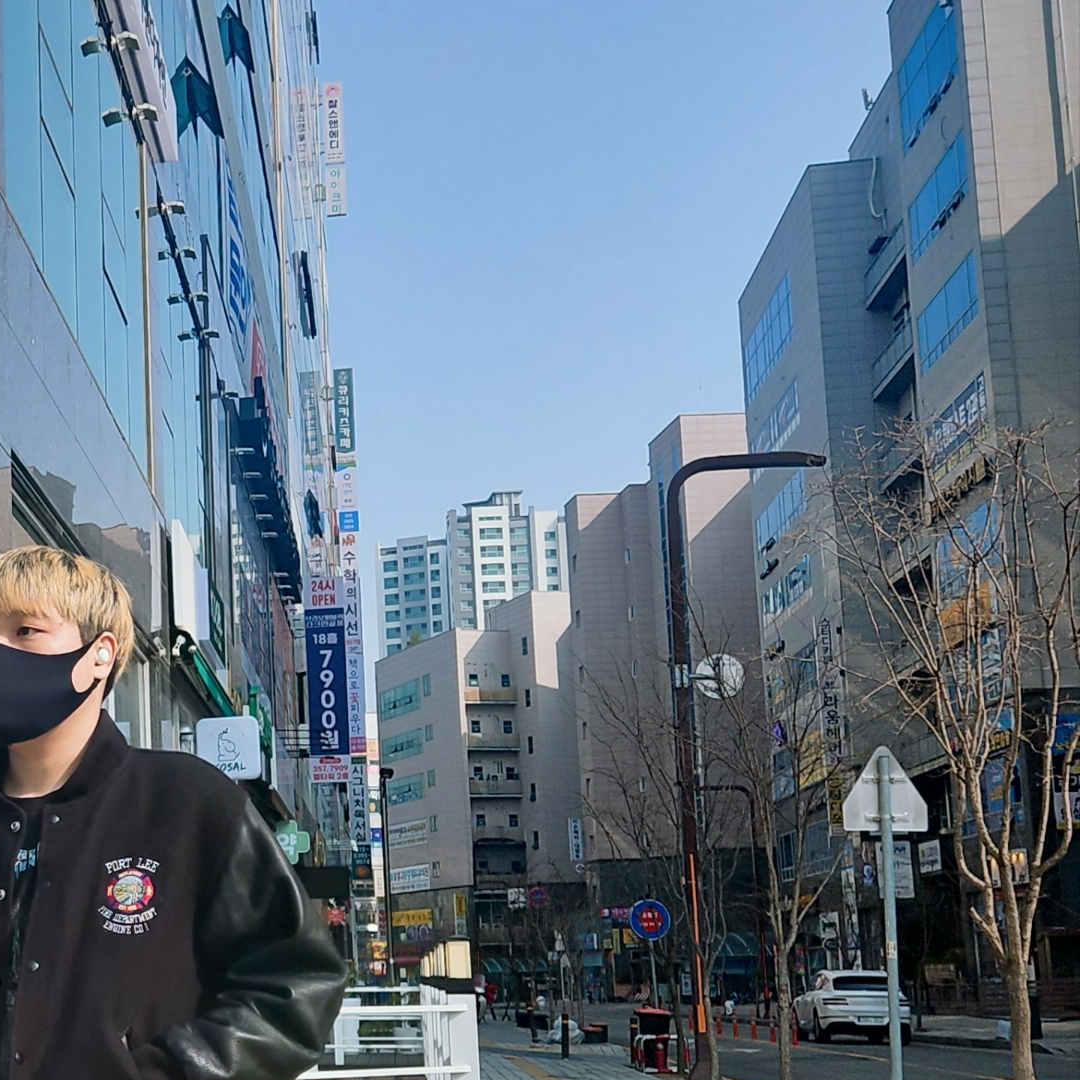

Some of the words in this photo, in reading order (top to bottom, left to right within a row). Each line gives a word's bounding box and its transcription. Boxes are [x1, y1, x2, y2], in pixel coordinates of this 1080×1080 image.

[311, 579, 335, 592] 24시
[311, 594, 336, 606] OPEN
[105, 857, 132, 874] FORT
[136, 857, 160, 873] LEE
[103, 920, 132, 934] ENGINE
[134, 924, 144, 934] CO
